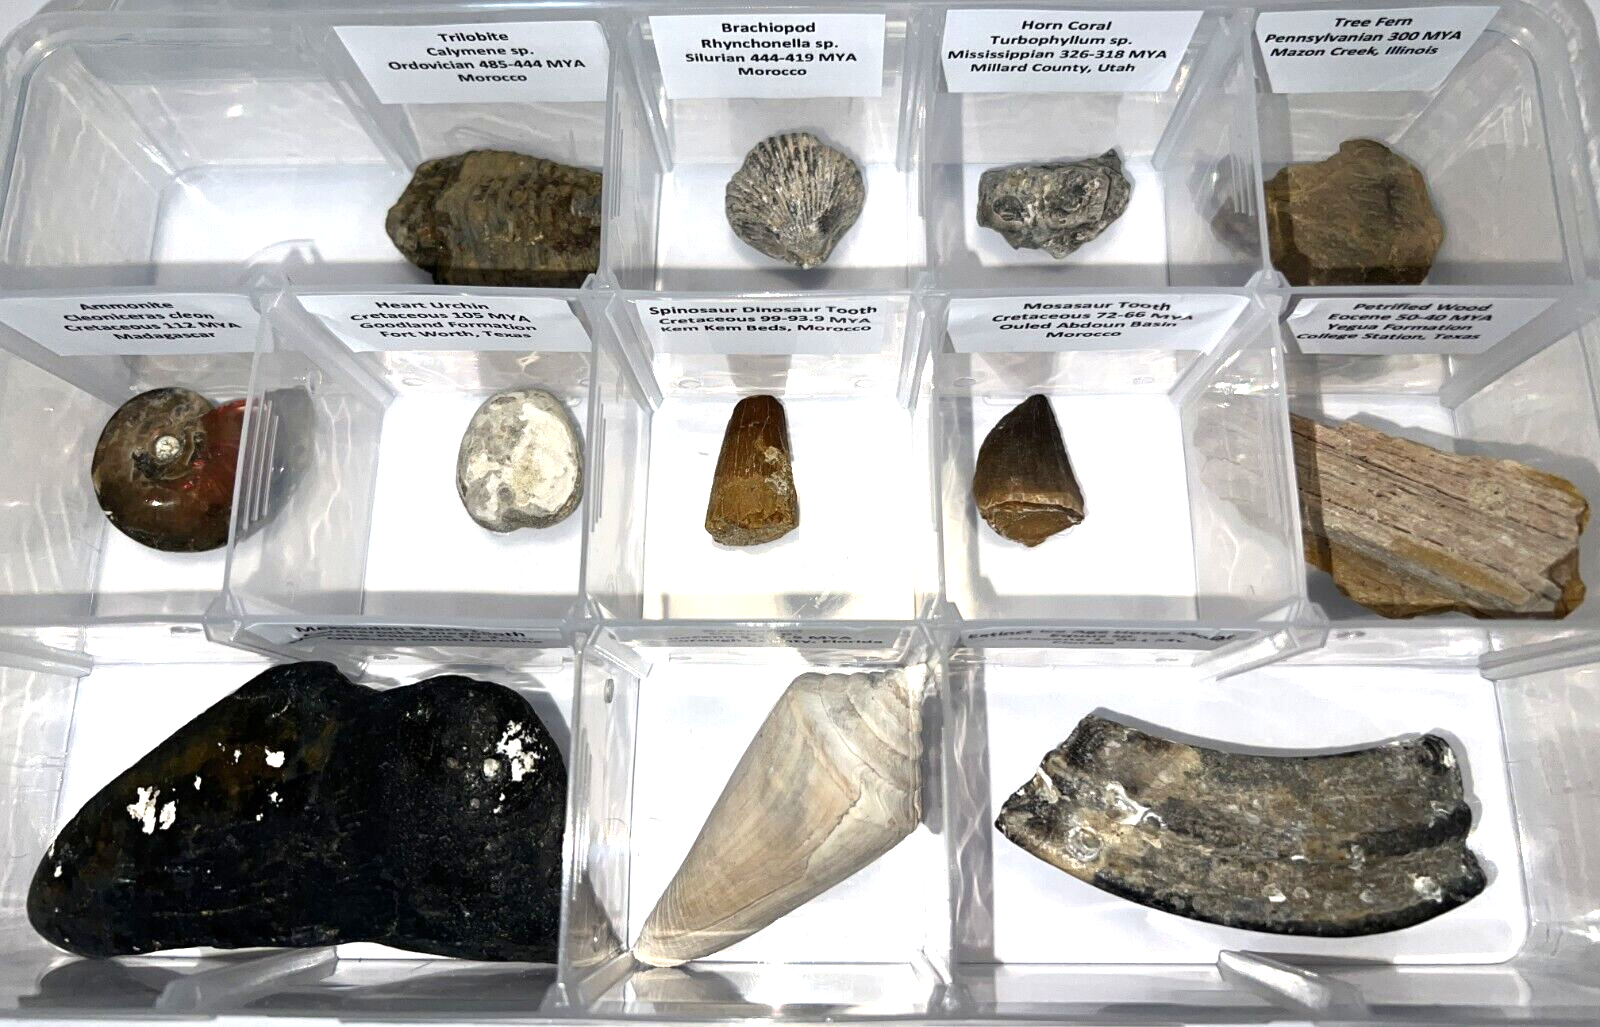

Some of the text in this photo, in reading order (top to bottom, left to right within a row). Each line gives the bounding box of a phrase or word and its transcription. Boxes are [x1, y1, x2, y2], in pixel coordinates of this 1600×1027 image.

[1022, 21, 1112, 30] Horn Coral
[1334, 17, 1413, 27] Tree Fern
[722, 22, 815, 34] Brachiopod
[438, 32, 508, 42] Trilobite
[990, 36, 1132, 46] Turbophyllum sp.
[1265, 31, 1461, 44] Pennsylvanian 300 MYA
[702, 39, 838, 50] Rhynchonella sp.
[427, 47, 534, 57] Calymene sp.
[948, 50, 1167, 60] Mississippian 326-318 MYA
[1270, 46, 1438, 56] Mazon Creek, Illinois
[686, 53, 857, 62] Silurian 444-419 MYA
[388, 59, 585, 70] Ordovician 485-444 MYA
[971, 63, 1135, 74] Millard County, Utah
[738, 67, 807, 76] Morocco
[457, 73, 527, 82] Morocco
[80, 302, 174, 310] Ammonite
[430, 302, 489, 310] Urchin
[650, 306, 737, 316] Spinosaur
[826, 306, 877, 315] Tooth
[1023, 302, 1170, 311] Mosasaur Tooth
[1354, 303, 1432, 311] Petrified
[64, 311, 214, 321] Cleoniceras cleon
[351, 312, 447, 321] Cretaceous
[488, 312, 531, 322] MYA
[660, 316, 755, 325] Cretaceous
[992, 312, 1090, 322] Cretaceous
[1150, 312, 1194, 320] MYA
[64, 323, 160, 331] Cretaceous
[360, 321, 537, 331] Goodland Formation
[747, 324, 791, 332] Beds,
[797, 324, 871, 332] Morocco
[999, 322, 1050, 330] Ouled
[1327, 323, 1472, 331] Yegua Formation
[113, 332, 216, 340] Madagascar
[485, 330, 531, 338] Texas
